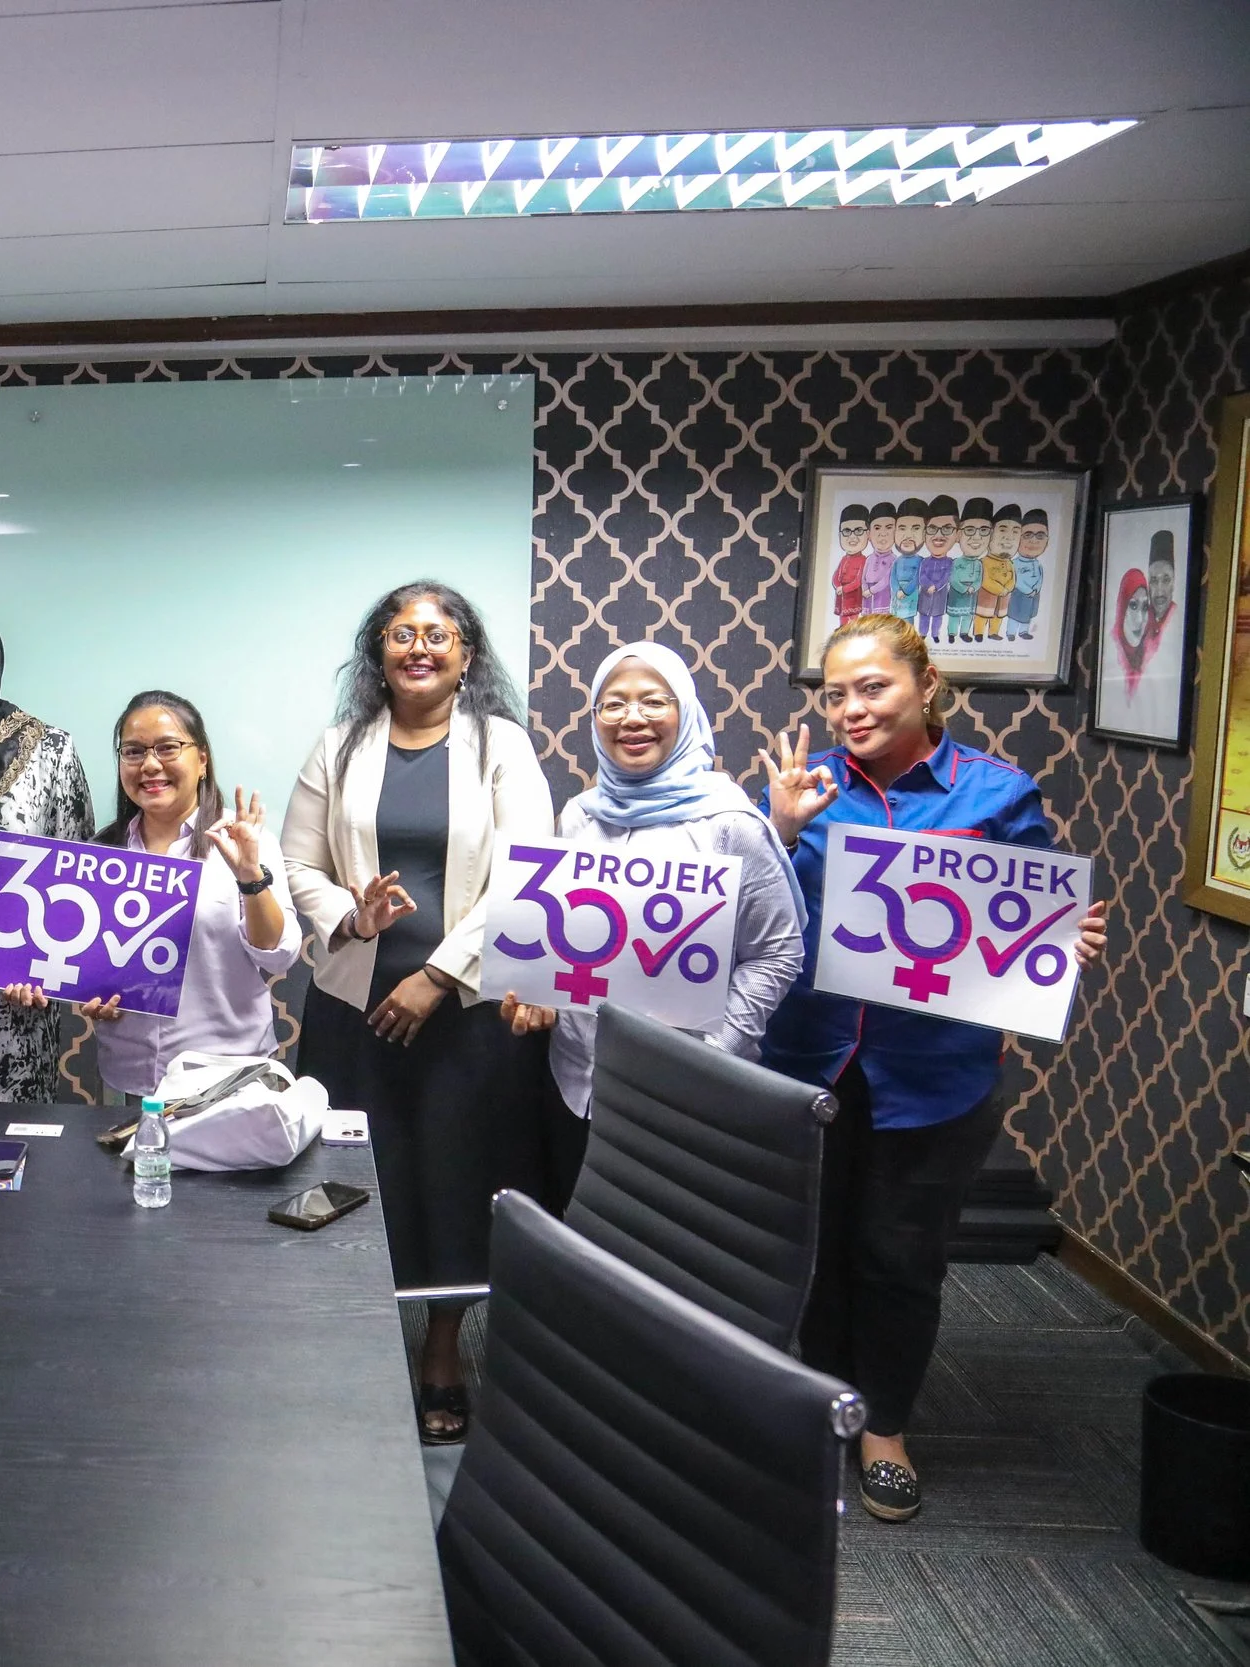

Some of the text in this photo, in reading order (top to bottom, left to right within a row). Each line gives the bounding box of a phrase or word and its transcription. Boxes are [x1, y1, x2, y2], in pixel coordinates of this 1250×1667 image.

[54, 850, 192, 897] PROJEK
[573, 852, 730, 897] PROJEK
[912, 845, 1078, 898] PROJEK
